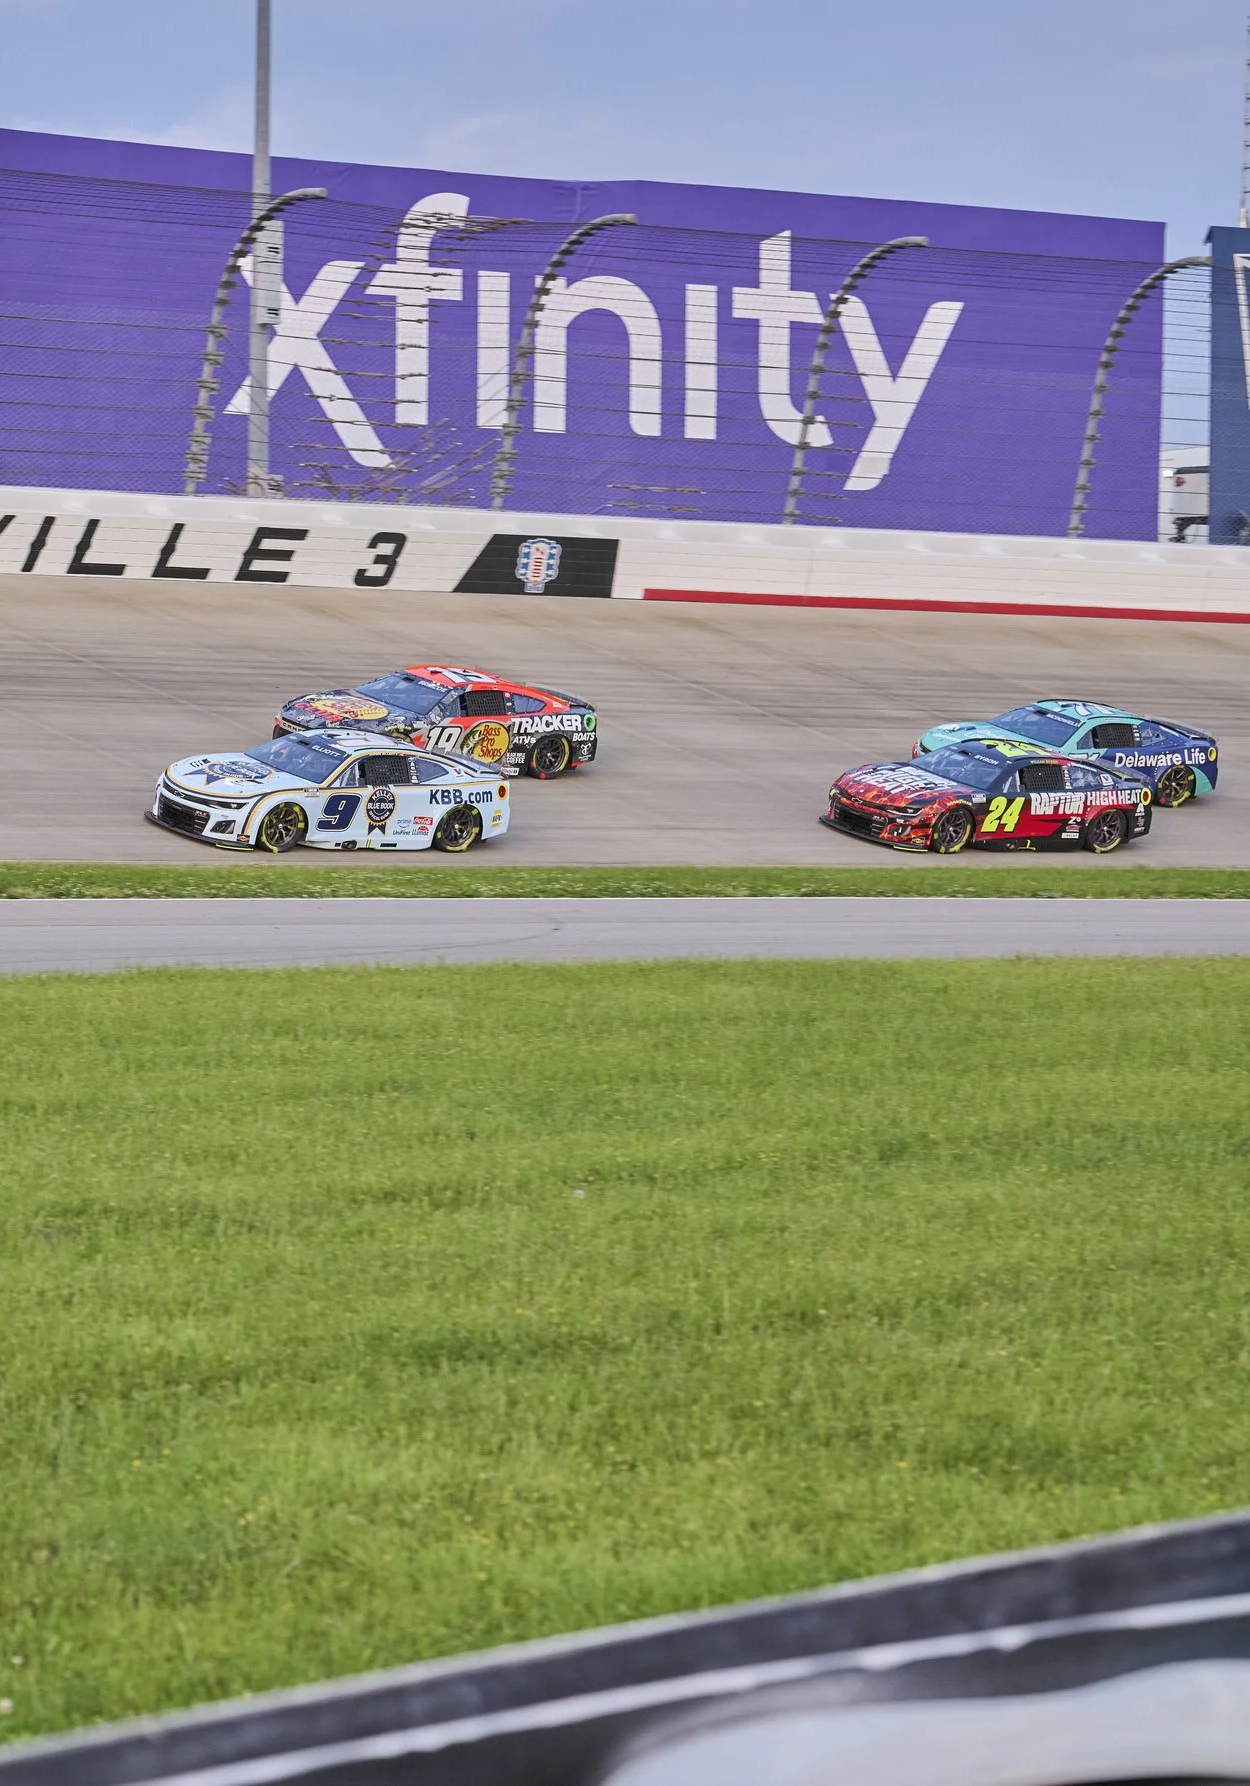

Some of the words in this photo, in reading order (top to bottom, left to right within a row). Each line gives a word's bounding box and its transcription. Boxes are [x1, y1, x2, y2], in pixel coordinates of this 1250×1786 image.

[224, 192, 964, 491] xfinity
[354, 531, 408, 587] 3
[482, 724, 501, 736] Bass
[510, 714, 582, 734] TRACKER
[426, 726, 462, 752] 19
[481, 736, 495, 746] Pro
[513, 735, 536, 745] ATVs
[572, 732, 595, 741] BOATS
[311, 745, 342, 757] ELLIOTT
[479, 746, 502, 759] Shops
[1114, 751, 1182, 768] Delaware
[1184, 748, 1206, 765] Life
[973, 754, 1000, 766] BYRON
[372, 790, 393, 801] KELLEY
[429, 789, 493, 805] KBB.com
[1030, 791, 1086, 815] RAPTOR
[1086, 791, 1117, 806] HIGH
[1117, 788, 1142, 804] HEAT
[316, 792, 363, 832] 9
[980, 796, 1026, 832] 24
